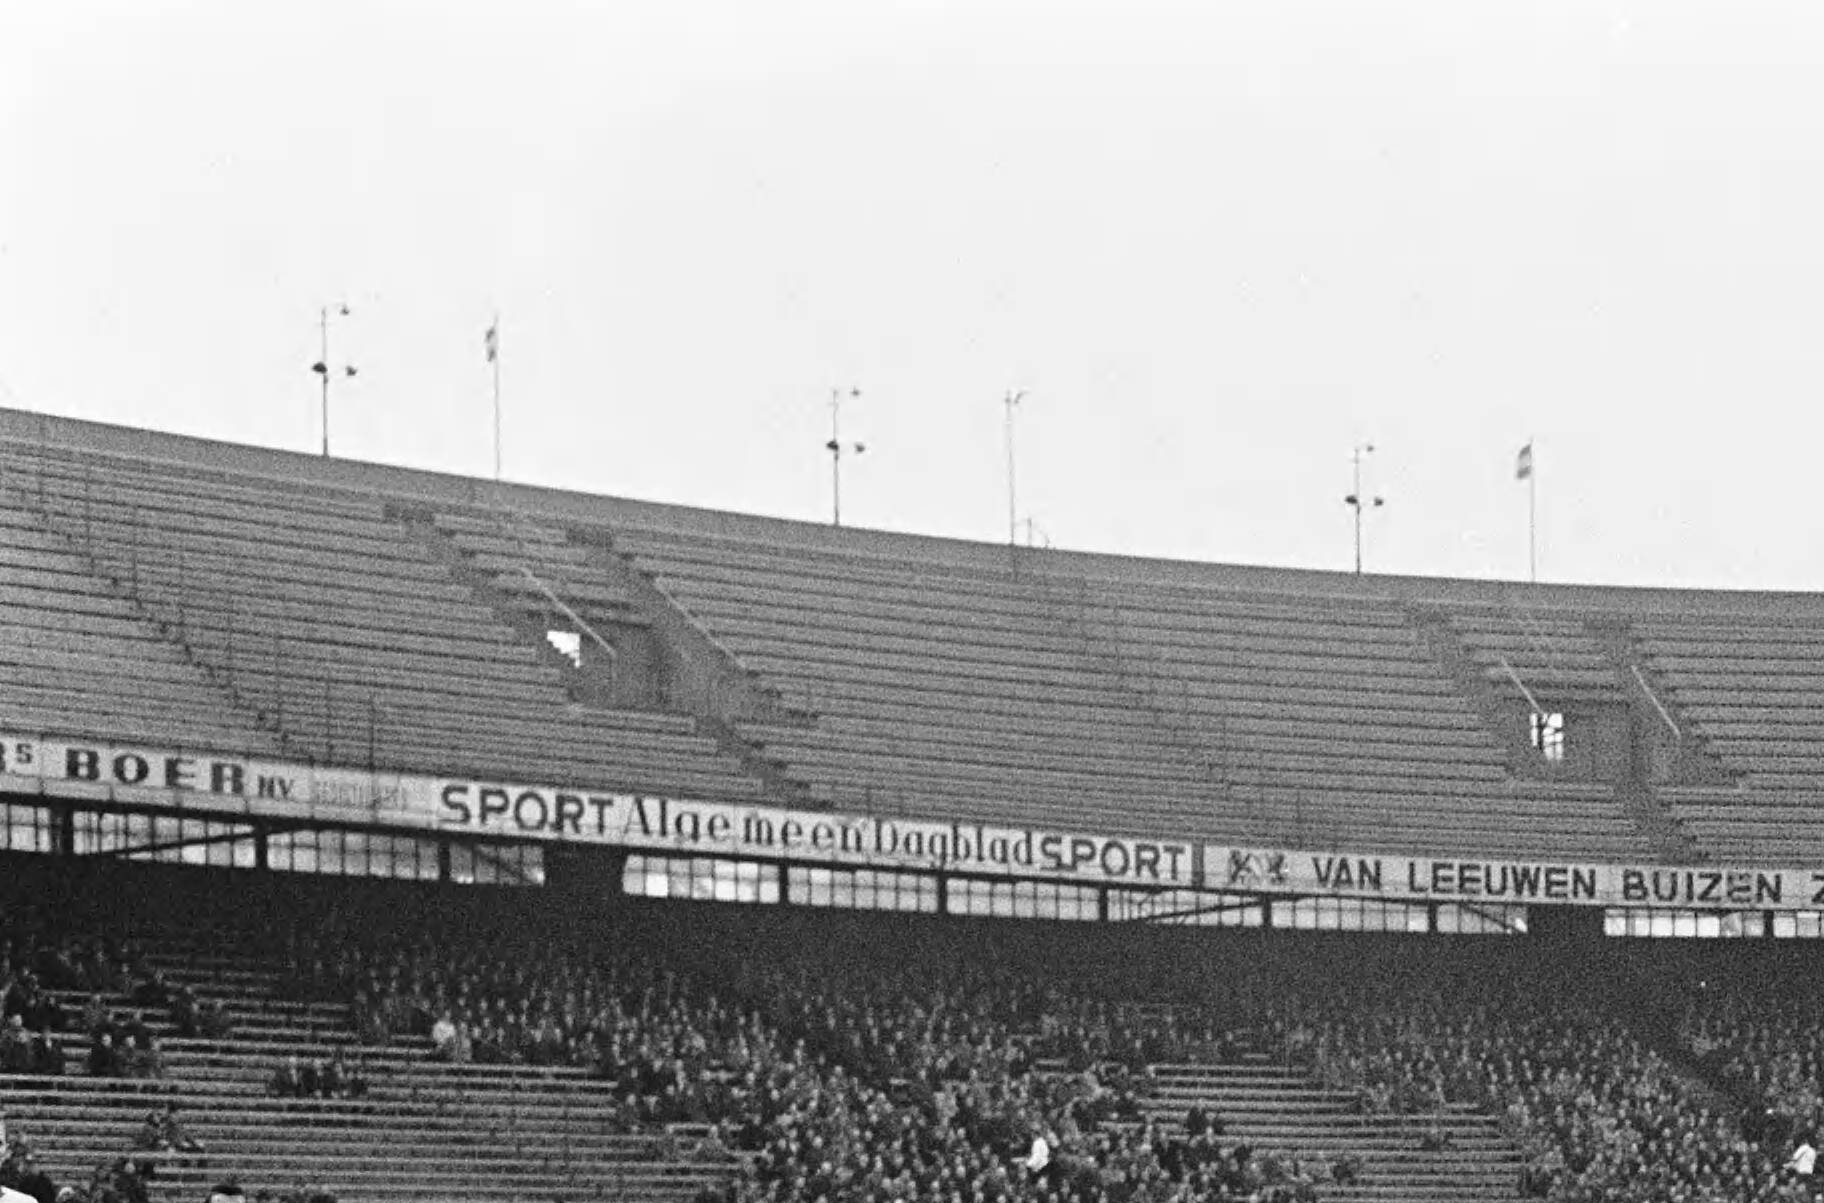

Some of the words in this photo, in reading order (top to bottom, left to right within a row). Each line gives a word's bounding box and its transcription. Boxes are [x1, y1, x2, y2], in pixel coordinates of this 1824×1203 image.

[64, 747, 245, 796] BOER
[440, 784, 616, 836] SPORT
[873, 818, 1034, 868] Dagblad
[1040, 834, 1186, 881] SPORT
[1312, 857, 1381, 890] VAN
[1408, 861, 1597, 898] LEEUWEN
[1622, 869, 1783, 902] BUIZEN
